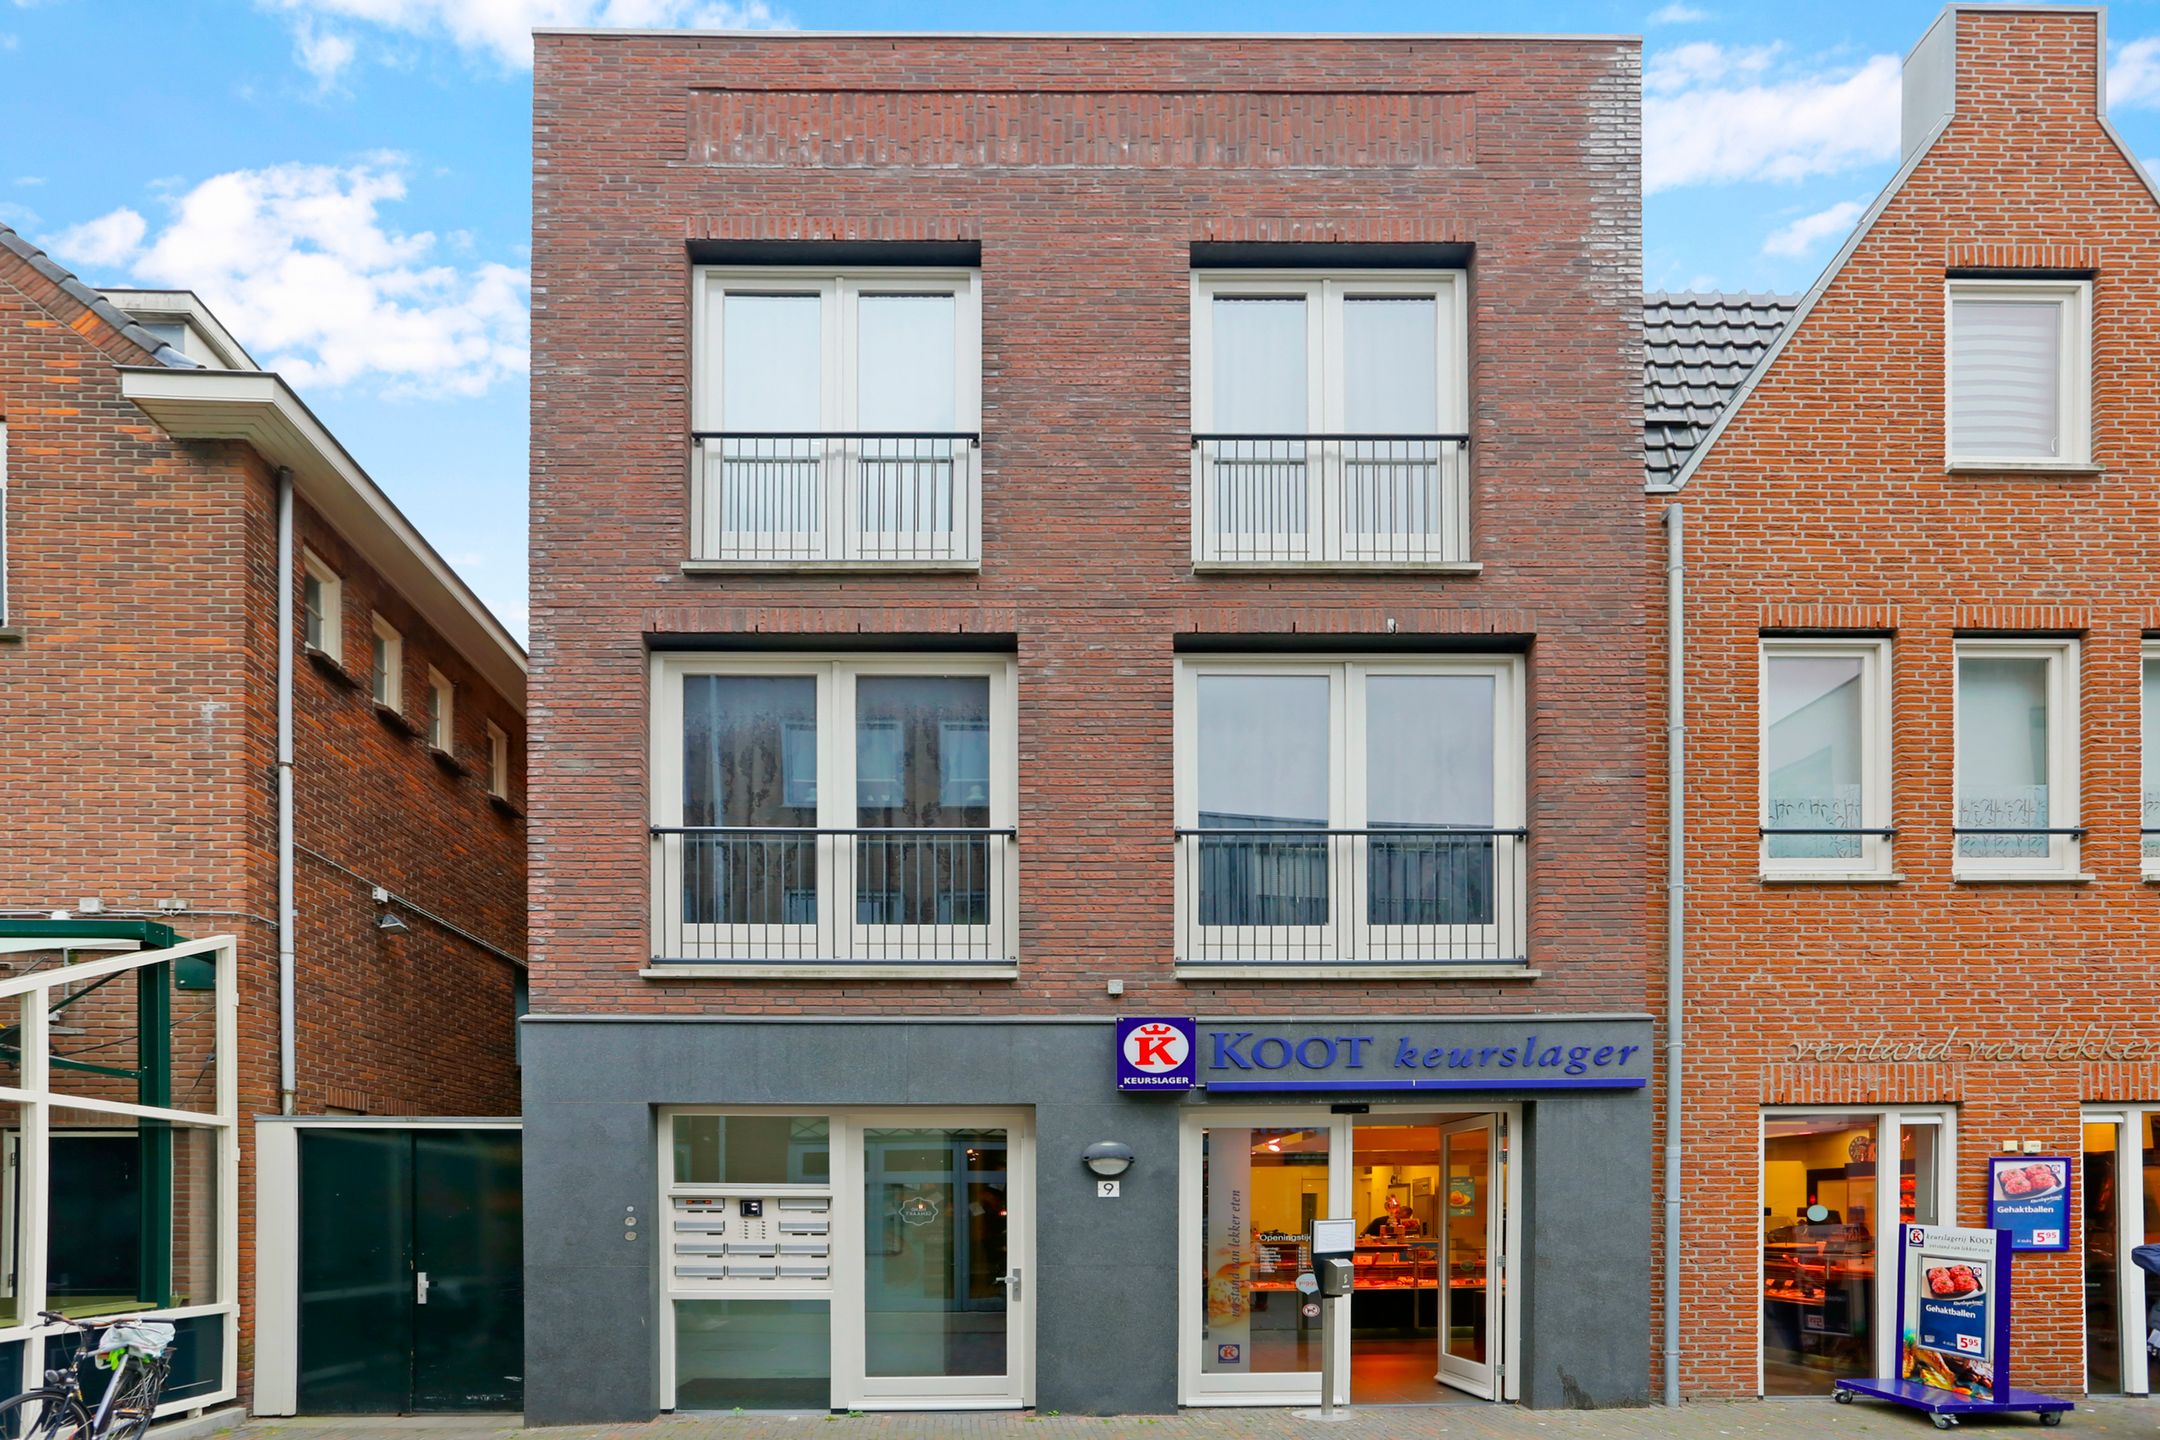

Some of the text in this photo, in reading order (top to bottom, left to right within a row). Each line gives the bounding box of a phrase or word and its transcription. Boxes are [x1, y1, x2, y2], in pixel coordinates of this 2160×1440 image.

[1134, 1036, 1178, 1066] K
[1789, 1022, 2160, 1063] verstand van lekker
[1209, 1032, 1640, 1076] KOOT keurslager
[1123, 1076, 1189, 1085] KEURSLAGER
[1103, 1183, 1114, 1195] 9
[1231, 1190, 1240, 1213] eten
[1228, 1214, 1240, 1248] lekker
[1260, 1233, 1312, 1242] Openingstij
[1969, 1235, 1994, 1245] KOOT
[1925, 1304, 1976, 1319] Gehaktballen
